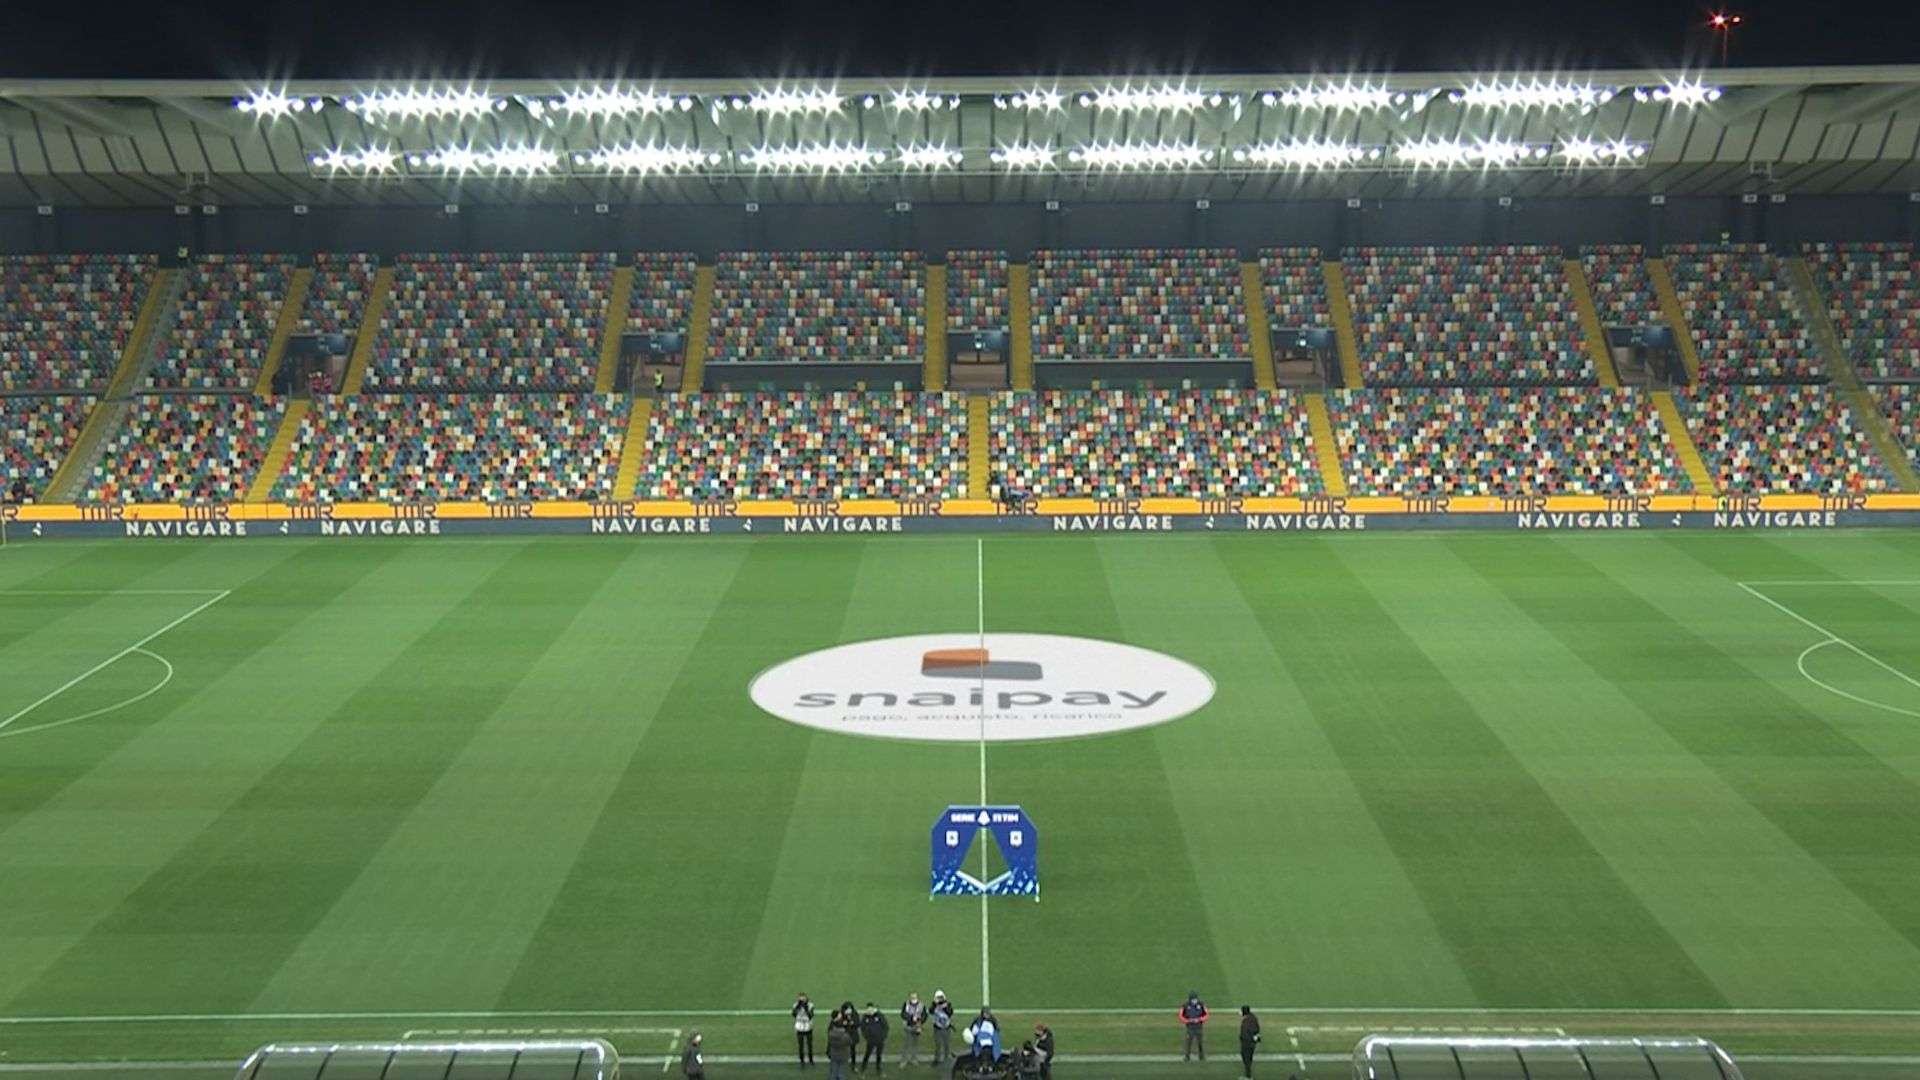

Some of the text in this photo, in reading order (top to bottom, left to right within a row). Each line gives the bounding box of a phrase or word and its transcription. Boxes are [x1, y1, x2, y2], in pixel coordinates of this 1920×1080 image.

[286, 503, 335, 519] TMR
[389, 503, 438, 519] TMR
[485, 502, 532, 518] TMR
[588, 501, 637, 518] TMR
[691, 501, 739, 517] TMR
[794, 501, 840, 517] TMR
[899, 500, 944, 516] TMR
[1099, 500, 1145, 515] TMR
[1200, 499, 1244, 515] TMR
[1300, 499, 1347, 514] TMR
[1405, 498, 1449, 514] TMR
[1501, 498, 1548, 513] TMR
[1602, 497, 1652, 512] TMR
[1818, 496, 1868, 512] TMR
[75, 504, 125, 520] TMR
[180, 504, 230, 520] TMR
[1517, 512, 1640, 527] NAVIGARE
[1714, 512, 1837, 527] NAVIGARE
[126, 521, 247, 536] NAVIGARE
[321, 520, 441, 535] NAVIGARE
[591, 518, 711, 533] NAVIGARE
[783, 517, 903, 532] NAVIGARE
[1053, 515, 1173, 530] NAVIGARE
[1246, 514, 1366, 529] NAVIGARE
[794, 687, 1167, 710] snaipay
[950, 813, 976, 823] SERIE
